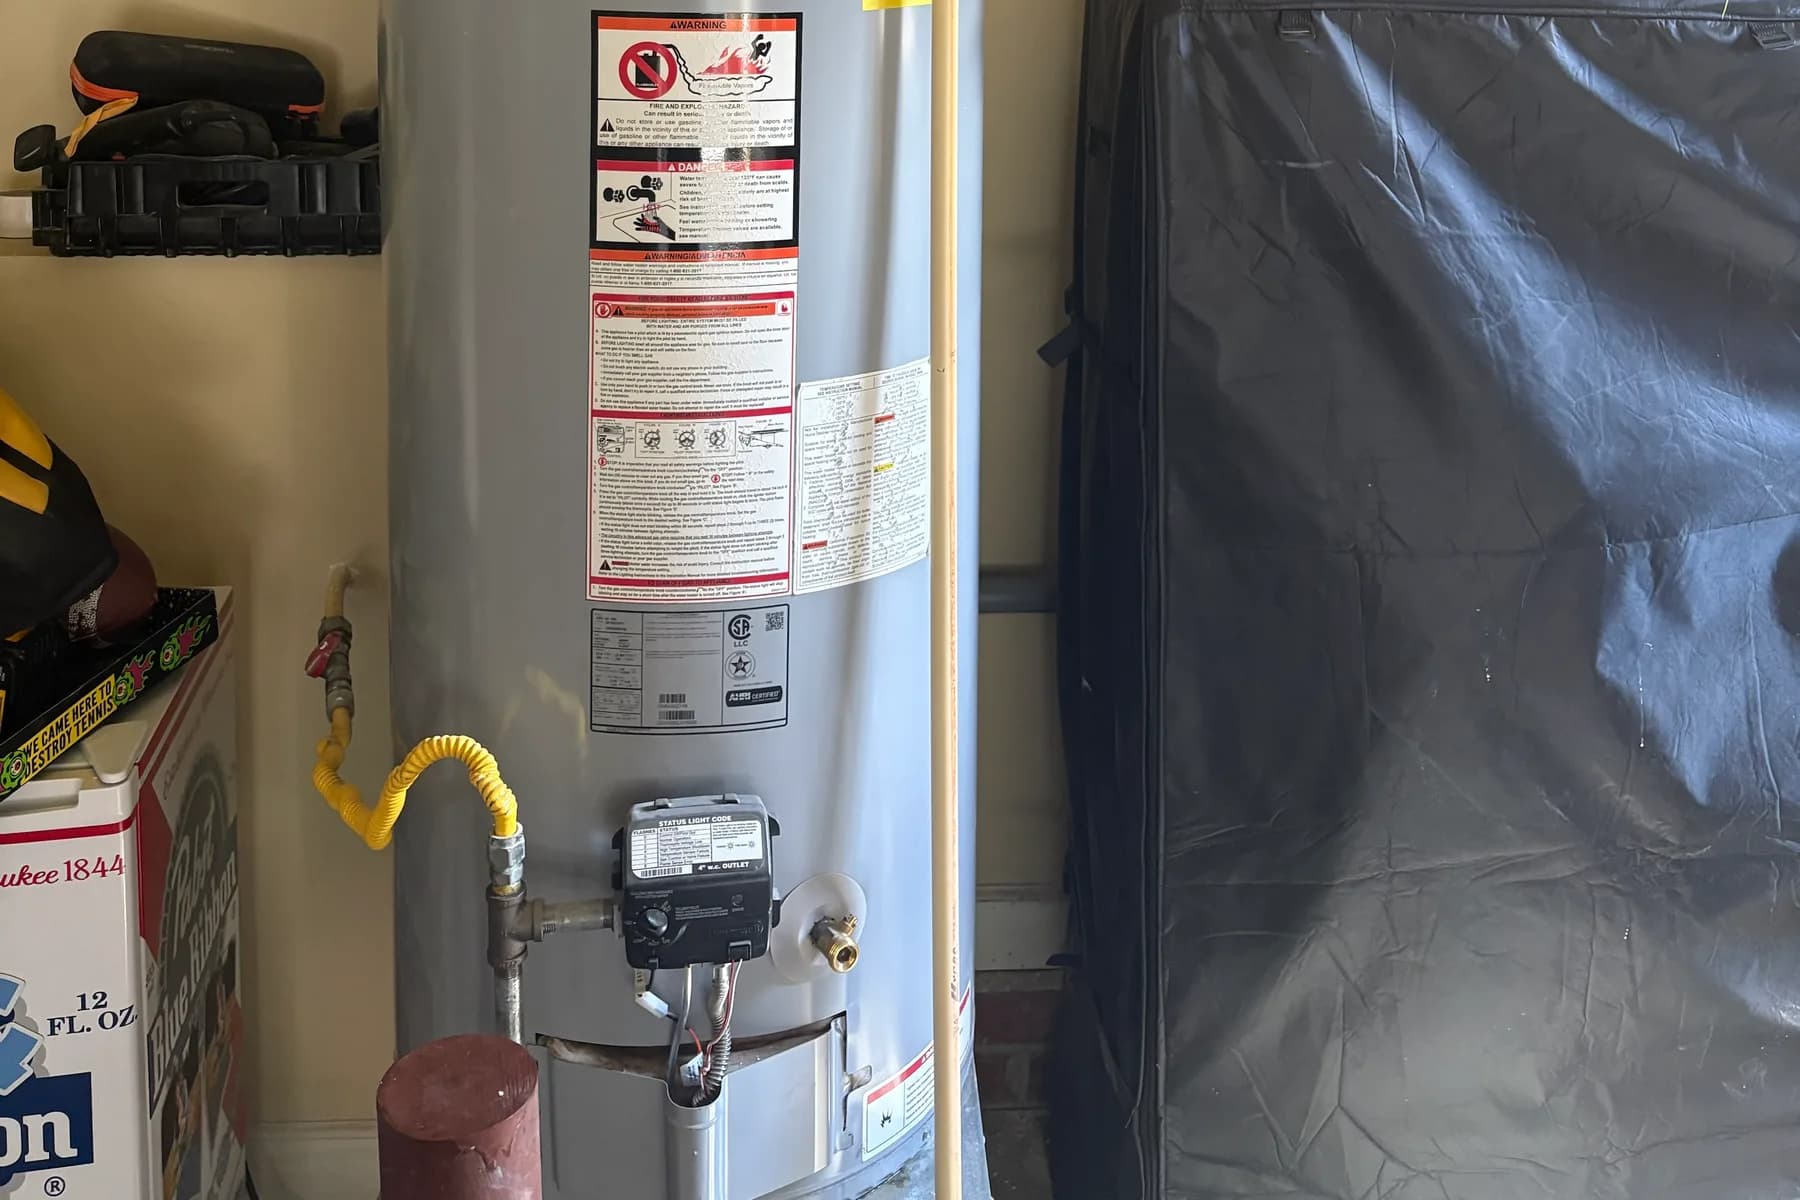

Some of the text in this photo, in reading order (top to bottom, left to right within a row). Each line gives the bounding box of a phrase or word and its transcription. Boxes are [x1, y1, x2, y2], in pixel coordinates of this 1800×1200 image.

[677, 20, 727, 30] WARNING
[42, 714, 70, 746] CAME
[72, 691, 97, 720] HERE
[98, 680, 111, 699] TO
[26, 696, 114, 778] DESTROY TENNIS
[658, 818, 686, 827] STATUS
[688, 816, 710, 824] LIGHT
[0, 854, 126, 888] ukee 1844
[76, 991, 108, 1012] 12
[46, 1003, 138, 1038] FL. OZ.
